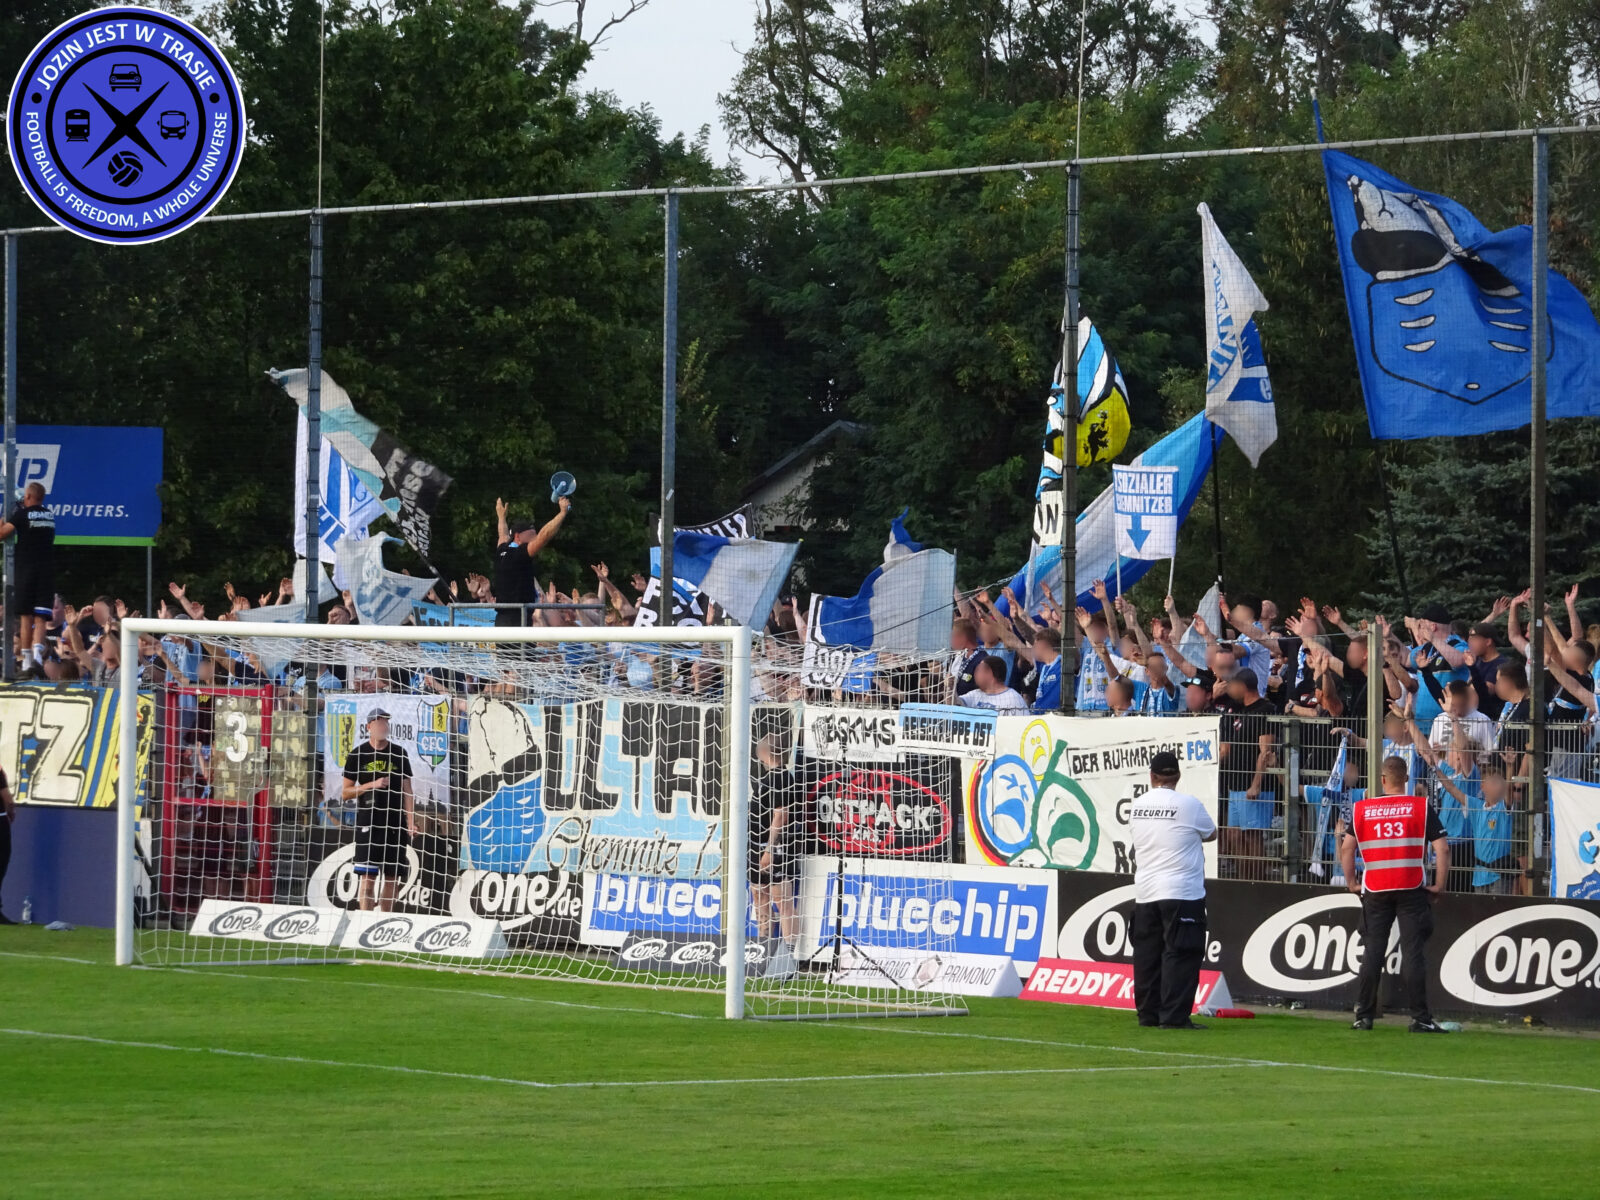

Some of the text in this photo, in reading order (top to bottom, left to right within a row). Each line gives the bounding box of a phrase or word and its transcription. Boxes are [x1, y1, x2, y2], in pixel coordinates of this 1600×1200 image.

[46, 504, 129, 518] MPUTERS.
[226, 711, 249, 763] 3
[973, 722, 993, 747] OST
[1073, 752, 1099, 775] DER
[1186, 740, 1212, 761] FCK
[1133, 809, 1177, 817] SECURITY
[1365, 806, 1413, 818] SECURITY
[1373, 821, 1404, 838] 133
[827, 878, 1039, 953] bluechip
[945, 965, 997, 986] PRIMONO
